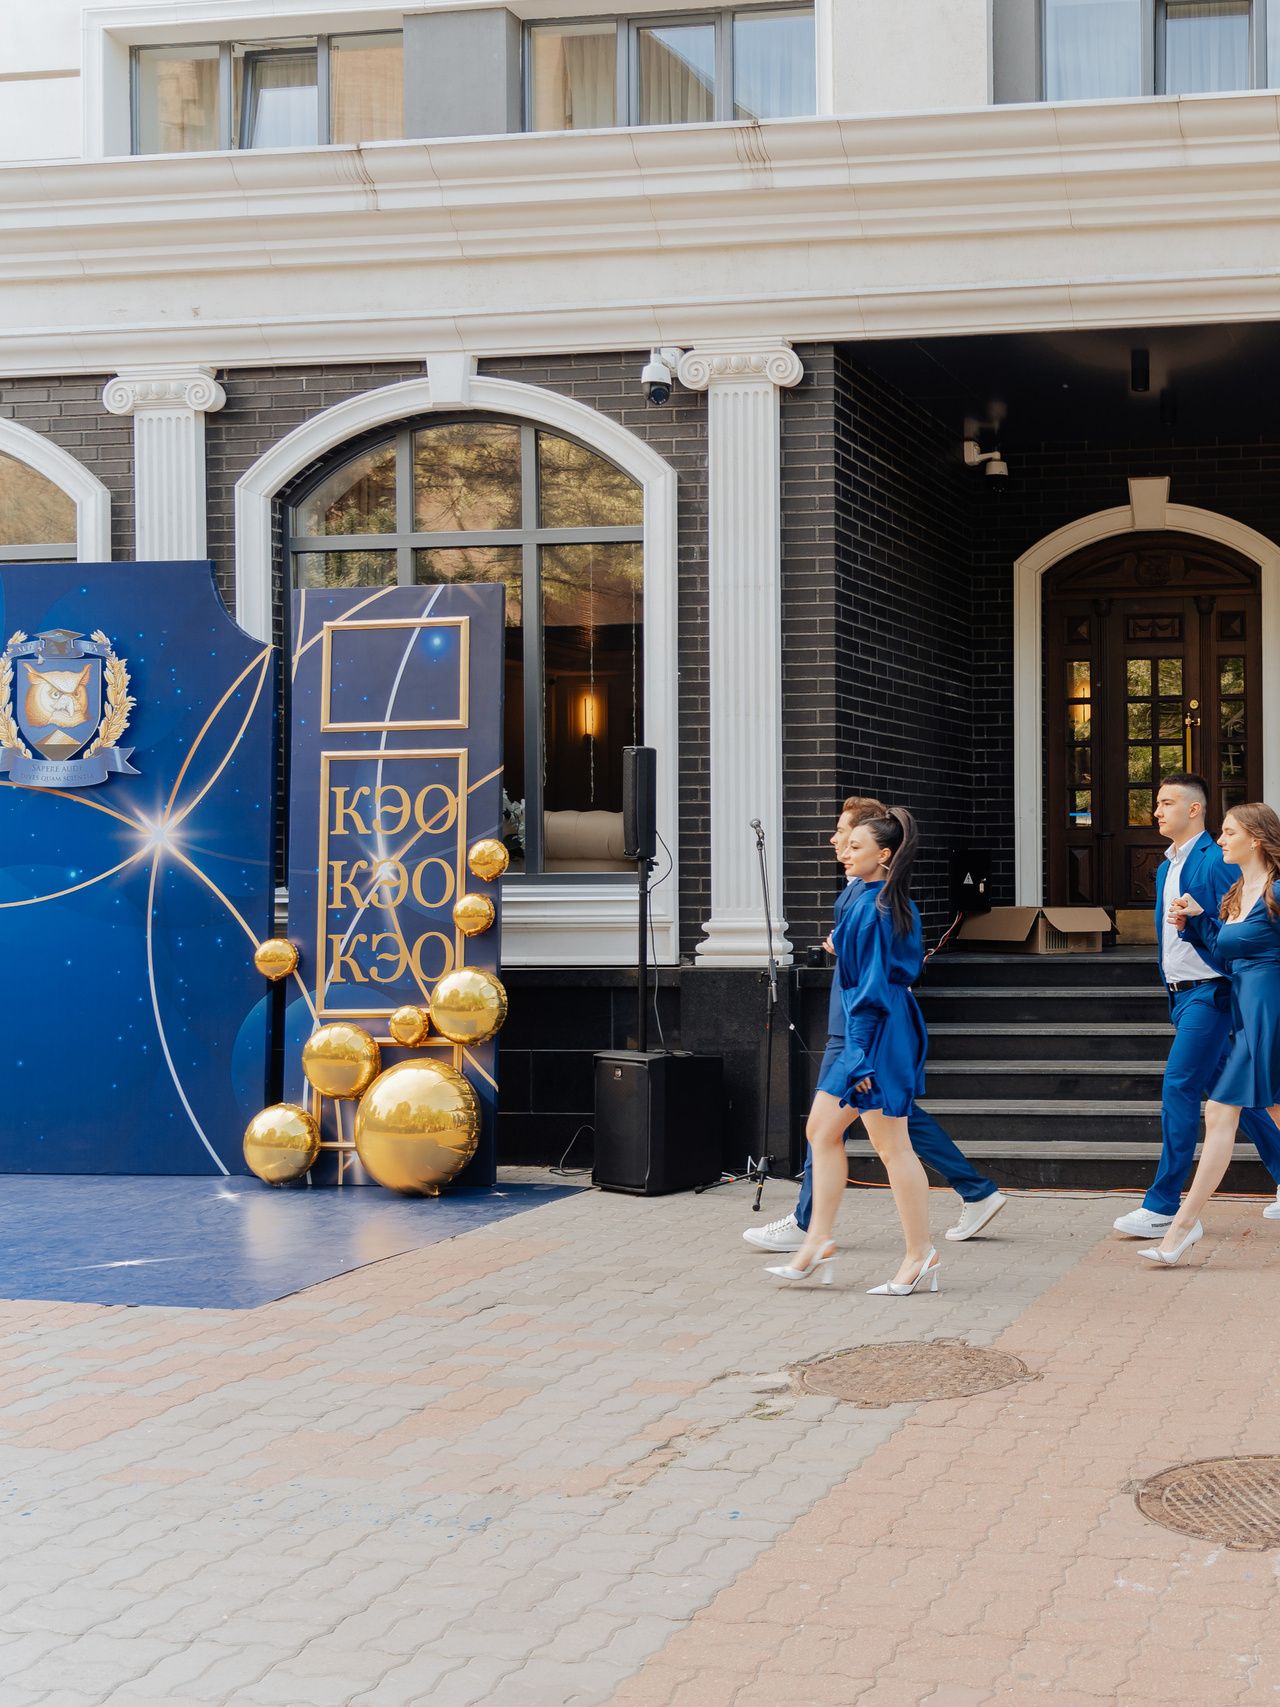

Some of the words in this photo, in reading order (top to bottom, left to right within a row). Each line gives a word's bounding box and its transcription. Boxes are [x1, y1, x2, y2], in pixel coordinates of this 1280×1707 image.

[330, 784, 457, 834] КЭО
[327, 858, 455, 909] КЭО
[327, 931, 455, 982] КЭО
